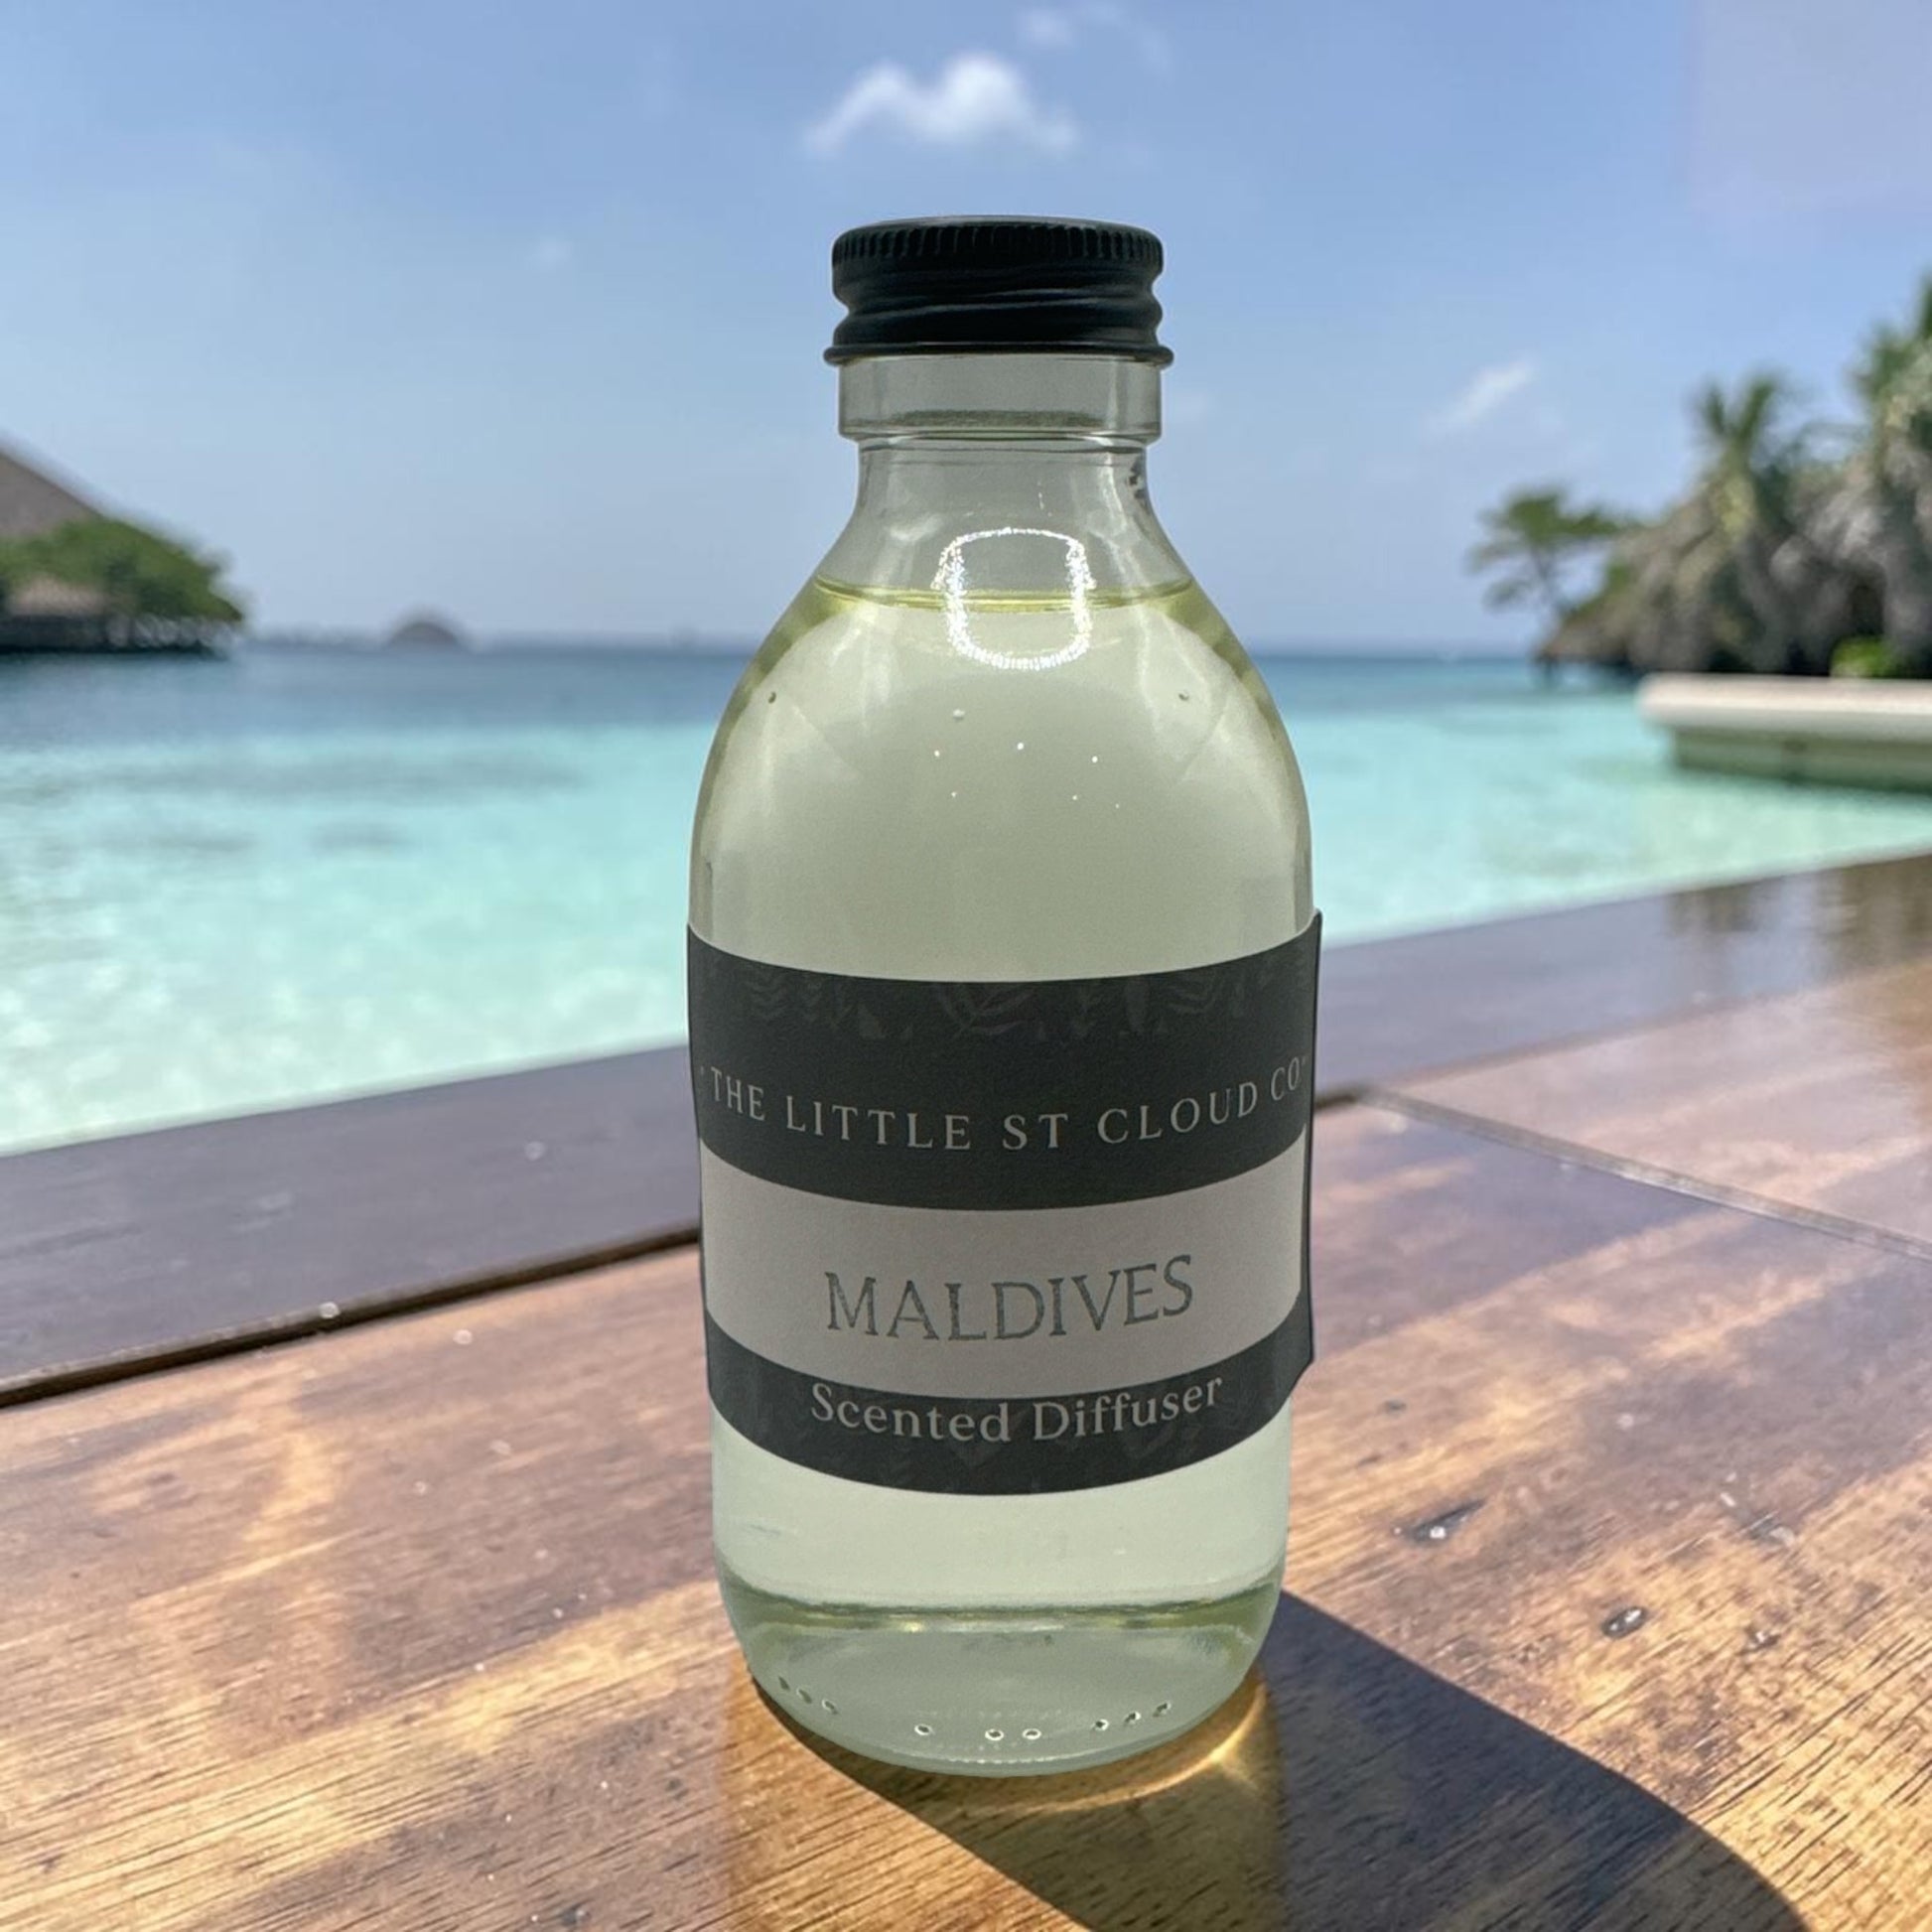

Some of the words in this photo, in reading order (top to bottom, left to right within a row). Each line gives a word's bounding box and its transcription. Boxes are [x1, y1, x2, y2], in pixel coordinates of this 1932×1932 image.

[786, 1095, 971, 1151] LITTLE
[1002, 1113, 1069, 1151] ST
[1097, 1081, 1258, 1144] CLOUD
[825, 1254, 1193, 1341] MALDIVES
[810, 1382, 1012, 1443] Scented
[1033, 1376, 1223, 1441] Diffuser
